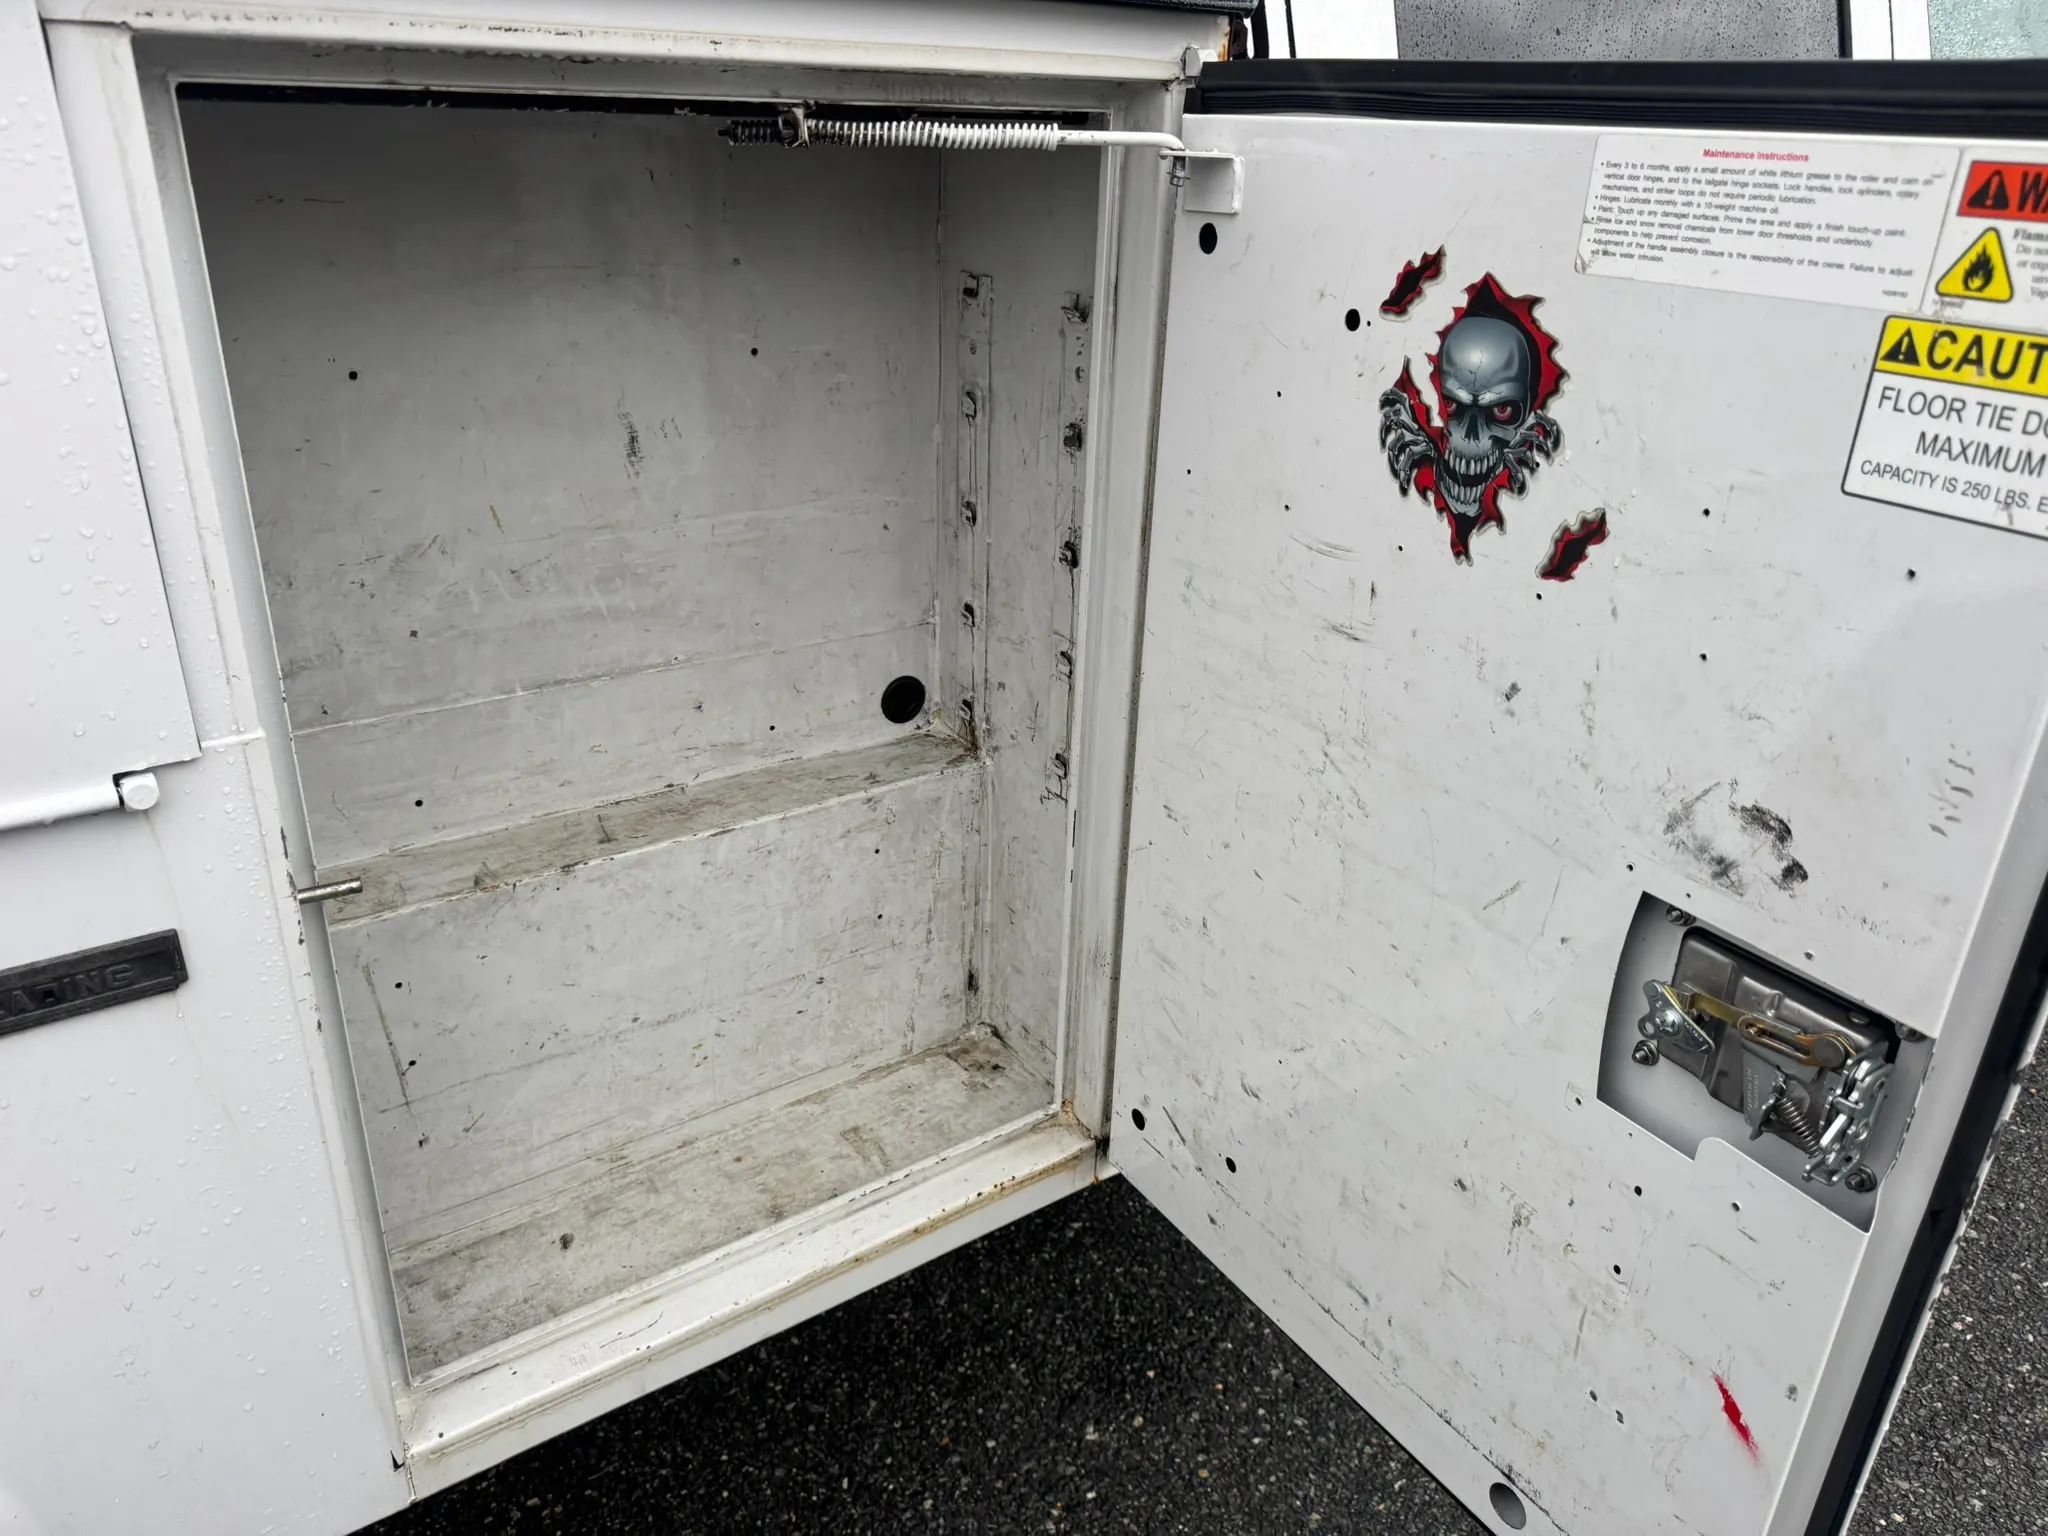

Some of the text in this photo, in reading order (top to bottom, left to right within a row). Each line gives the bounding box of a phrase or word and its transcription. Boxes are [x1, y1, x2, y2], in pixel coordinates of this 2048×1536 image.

[1702, 149, 1755, 159] Maintenance
[1603, 172, 1625, 180] vertical
[1626, 173, 1641, 181] door
[1667, 175, 1680, 183] and
[1682, 176, 1689, 184] to
[1704, 178, 1729, 188] tailgate
[1730, 179, 1750, 189] hinge
[1783, 182, 1801, 191] Lock
[1837, 185, 1854, 194] lock
[1605, 161, 1622, 170] Every
[1674, 164, 1691, 173] apply
[1700, 166, 1718, 174] small
[1720, 167, 1746, 175] amount
[1749, 168, 1756, 176] of
[1758, 169, 1777, 177] white
[1805, 173, 1831, 181] grease
[1833, 173, 1842, 181] to
[1844, 173, 1858, 181] the
[1860, 174, 1879, 183] roller
[1883, 175, 1898, 184] and
[1623, 195, 1652, 204] Lubricate
[1652, 197, 1678, 208] monthly
[1680, 199, 1694, 207] with
[1703, 201, 1736, 212] 10-weight
[1738, 204, 1768, 213] machine
[1642, 185, 1654, 193] and
[1677, 188, 1695, 197] loops
[1722, 191, 1746, 201] require
[1747, 192, 1776, 203] periodic
[2017, 171, 2048, 213] W
[1594, 226, 1629, 237] components
[1640, 231, 1653, 240] help
[1655, 232, 1678, 242] prevent
[1617, 206, 1634, 214] Touch
[1636, 209, 1645, 217] up
[1647, 210, 1658, 218] any
[1660, 210, 1690, 220] damaged
[1723, 215, 1743, 223] Prime
[1745, 216, 1757, 224] the
[1777, 219, 1792, 227] and
[1793, 220, 1814, 230] apply
[1824, 222, 1845, 231] finish
[1846, 224, 1883, 236] touch-up
[1625, 218, 1637, 226] and
[1657, 221, 1682, 230] removal
[1684, 223, 1716, 233] chemicals
[1718, 226, 1734, 234] from
[1736, 227, 1755, 236] lower
[1757, 229, 1774, 238] door
[1776, 231, 1814, 241] thresholds
[1815, 234, 1831, 242] and
[1832, 235, 1873, 248] underbody
[1591, 237, 1624, 248] Adjustment
[1634, 241, 1645, 249] the
[1646, 243, 1668, 251] handle
[1669, 245, 1699, 256] assembly
[1701, 248, 1725, 257] closure
[1727, 250, 1734, 258] is
[1735, 251, 1748, 259] the
[1748, 252, 1794, 265] responsibility
[1795, 257, 1805, 265] of
[1806, 258, 1820, 266] the
[1848, 262, 1875, 272] Failure
[1876, 265, 1887, 273] to
[1888, 266, 1914, 277] adjust
[1619, 251, 1635, 259] water
[1926, 329, 2048, 385] CAUT
[1877, 386, 1967, 424] FLOOR
[1975, 401, 2018, 431] TIE
[1915, 431, 2047, 478] MAXIMUM
[1860, 459, 1939, 489] CAPACITY
[1941, 476, 1958, 493] IS
[1961, 480, 1991, 501] 250
[1993, 488, 2031, 511] LBS.
